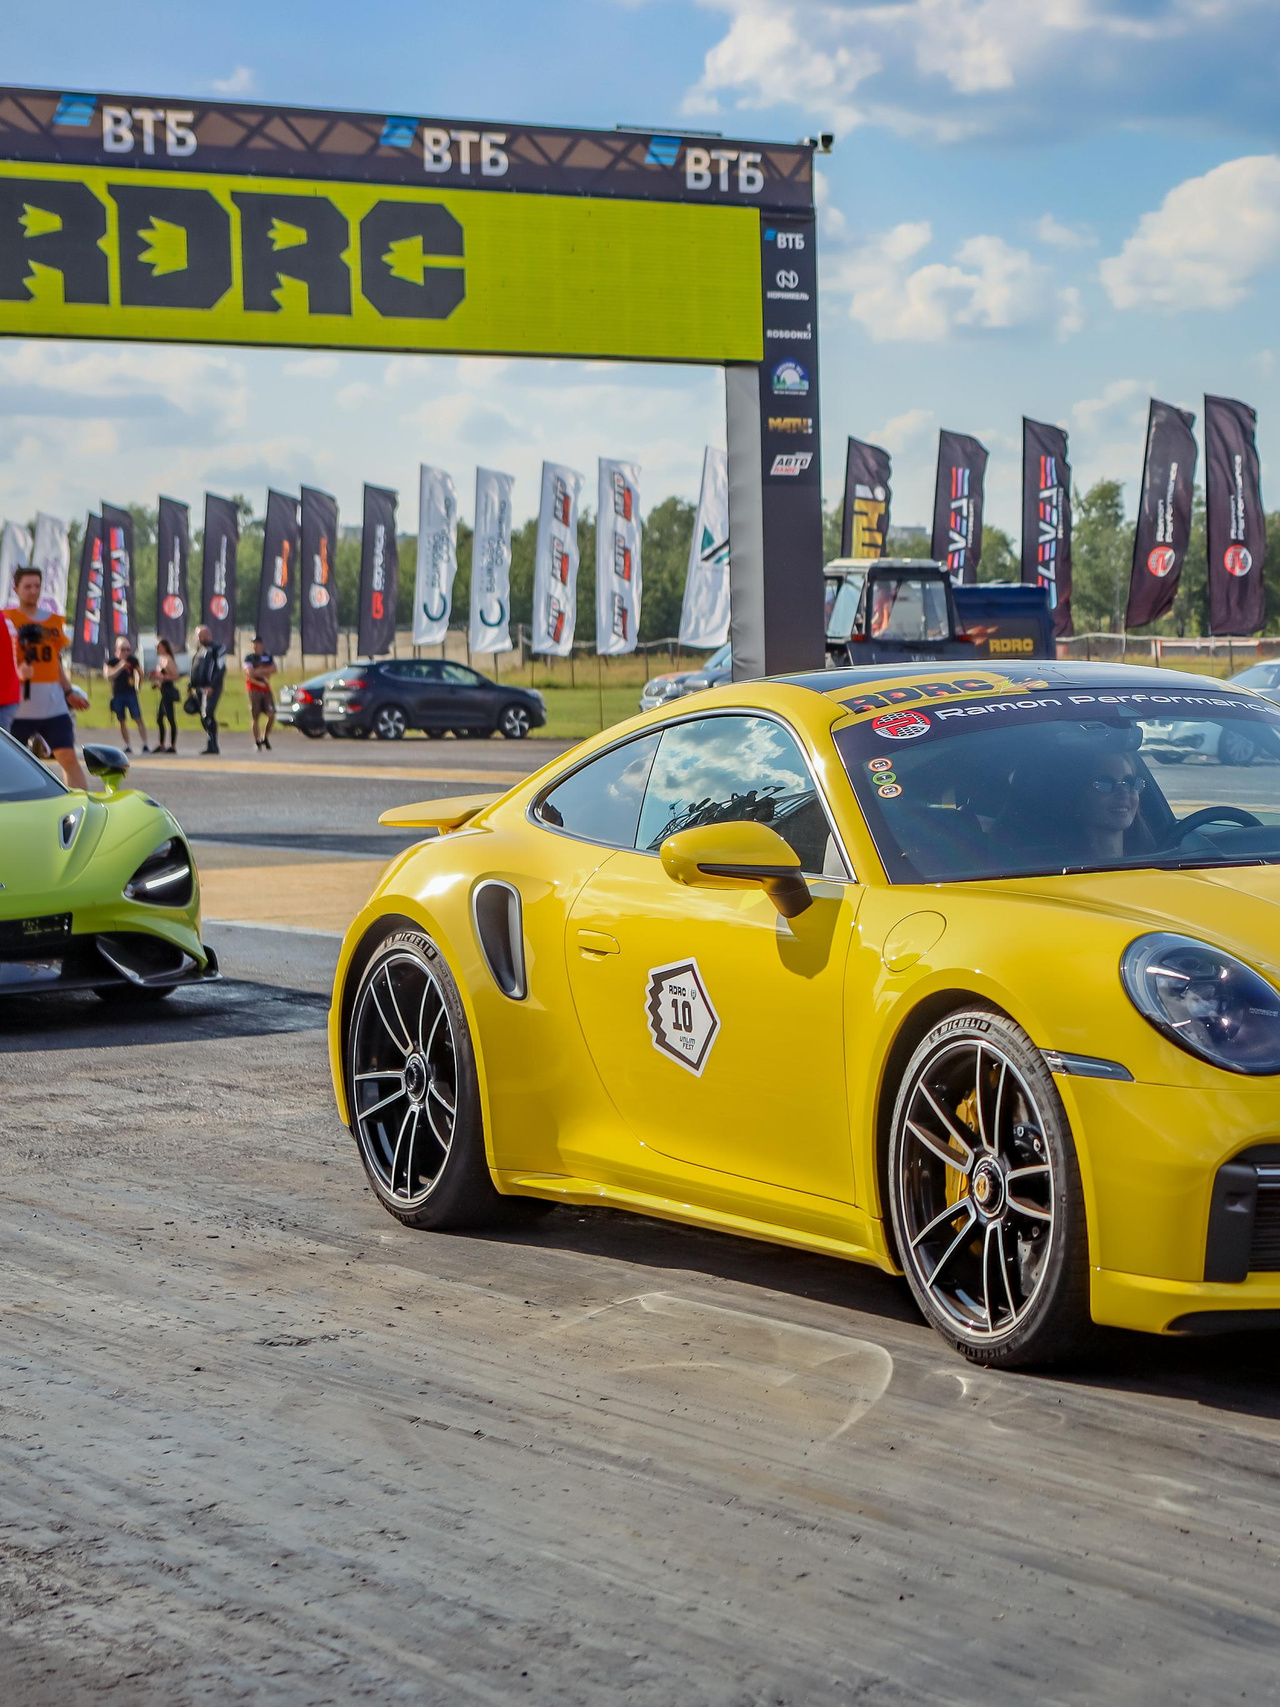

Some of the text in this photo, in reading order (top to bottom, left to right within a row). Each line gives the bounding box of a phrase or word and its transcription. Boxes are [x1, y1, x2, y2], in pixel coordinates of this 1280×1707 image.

[102, 105, 198, 157] ВТБ
[423, 127, 509, 177] ВТБ
[686, 147, 765, 194] ВТБ
[0, 177, 466, 319] RDRC
[777, 232, 805, 250] ВТБ
[989, 638, 1034, 653] RDRC
[838, 679, 997, 714] RDRC
[934, 698, 1062, 721] Ramon
[391, 932, 435, 958] MICHELIN
[669, 985, 687, 997] RDRC
[671, 998, 693, 1033] 10
[940, 1018, 989, 1034] MICHELIN
[682, 1043, 695, 1051] FEST
